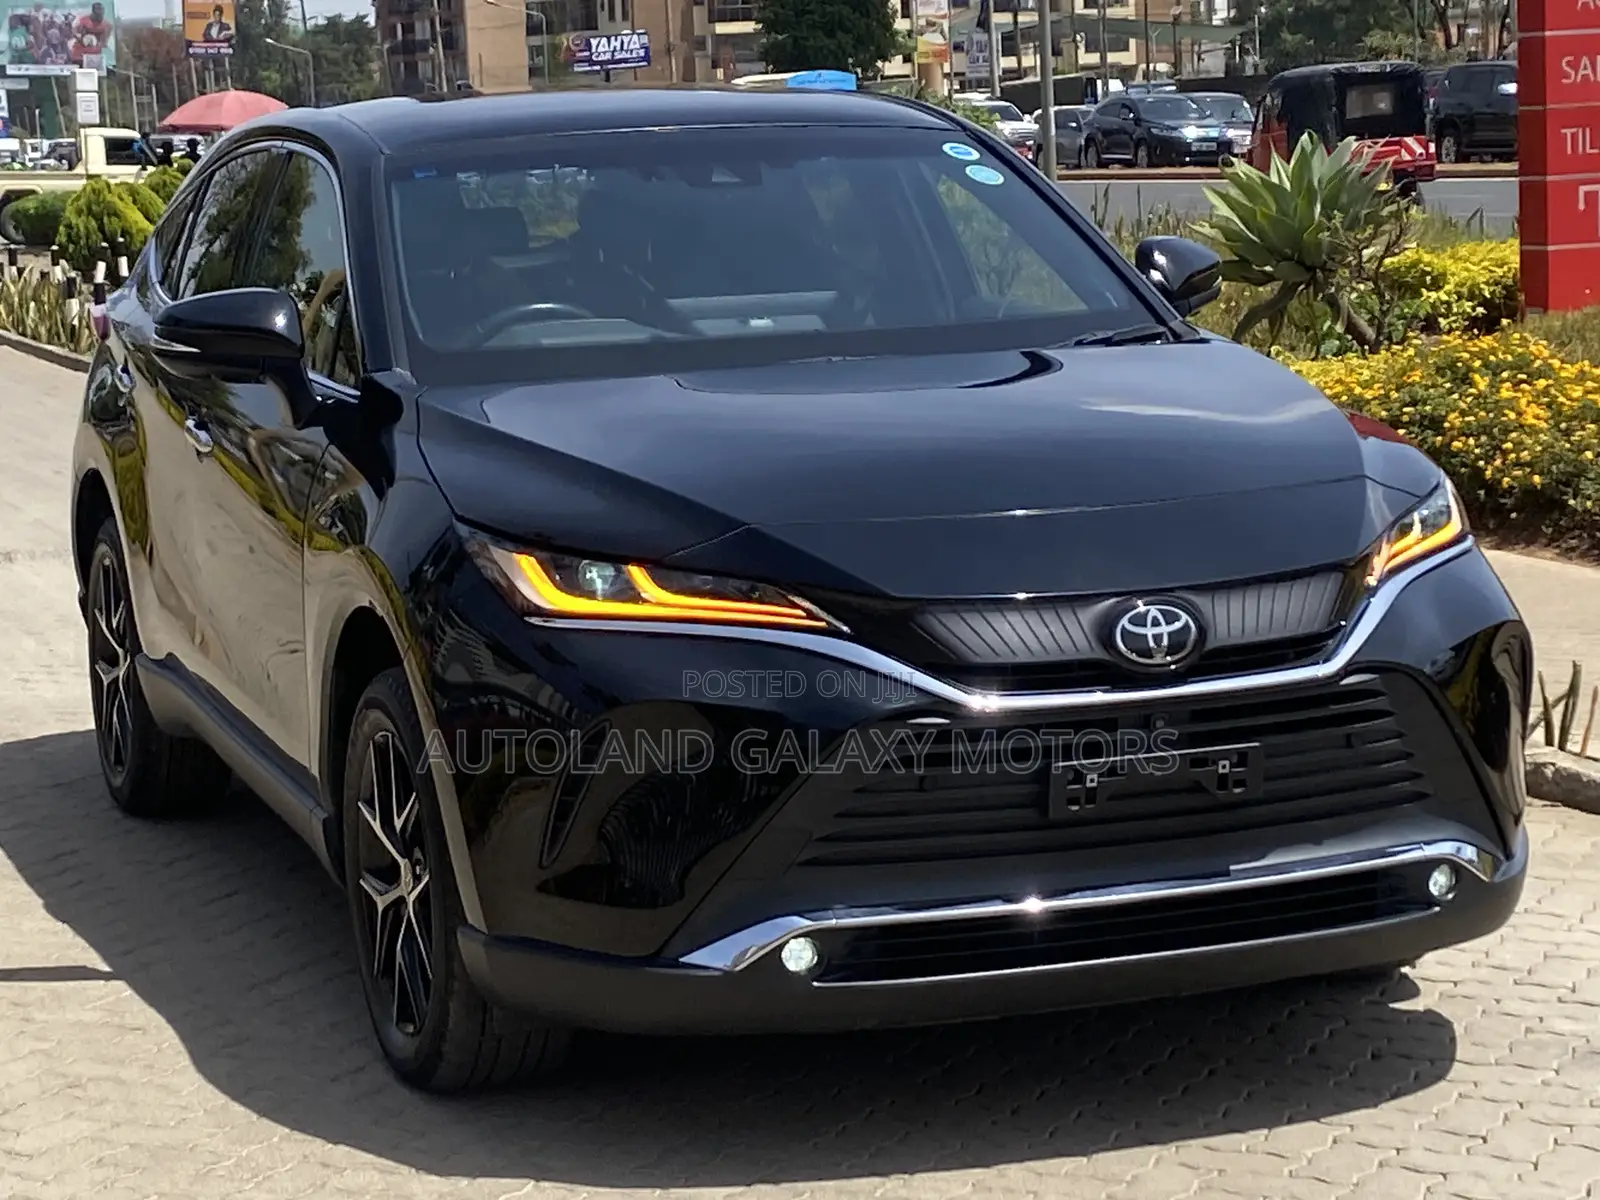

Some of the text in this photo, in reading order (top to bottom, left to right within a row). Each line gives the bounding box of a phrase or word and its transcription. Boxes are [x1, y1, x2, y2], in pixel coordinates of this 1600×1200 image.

[590, 34, 640, 53] YAHYA
[592, 51, 612, 61] CAR
[613, 49, 645, 60] SALES
